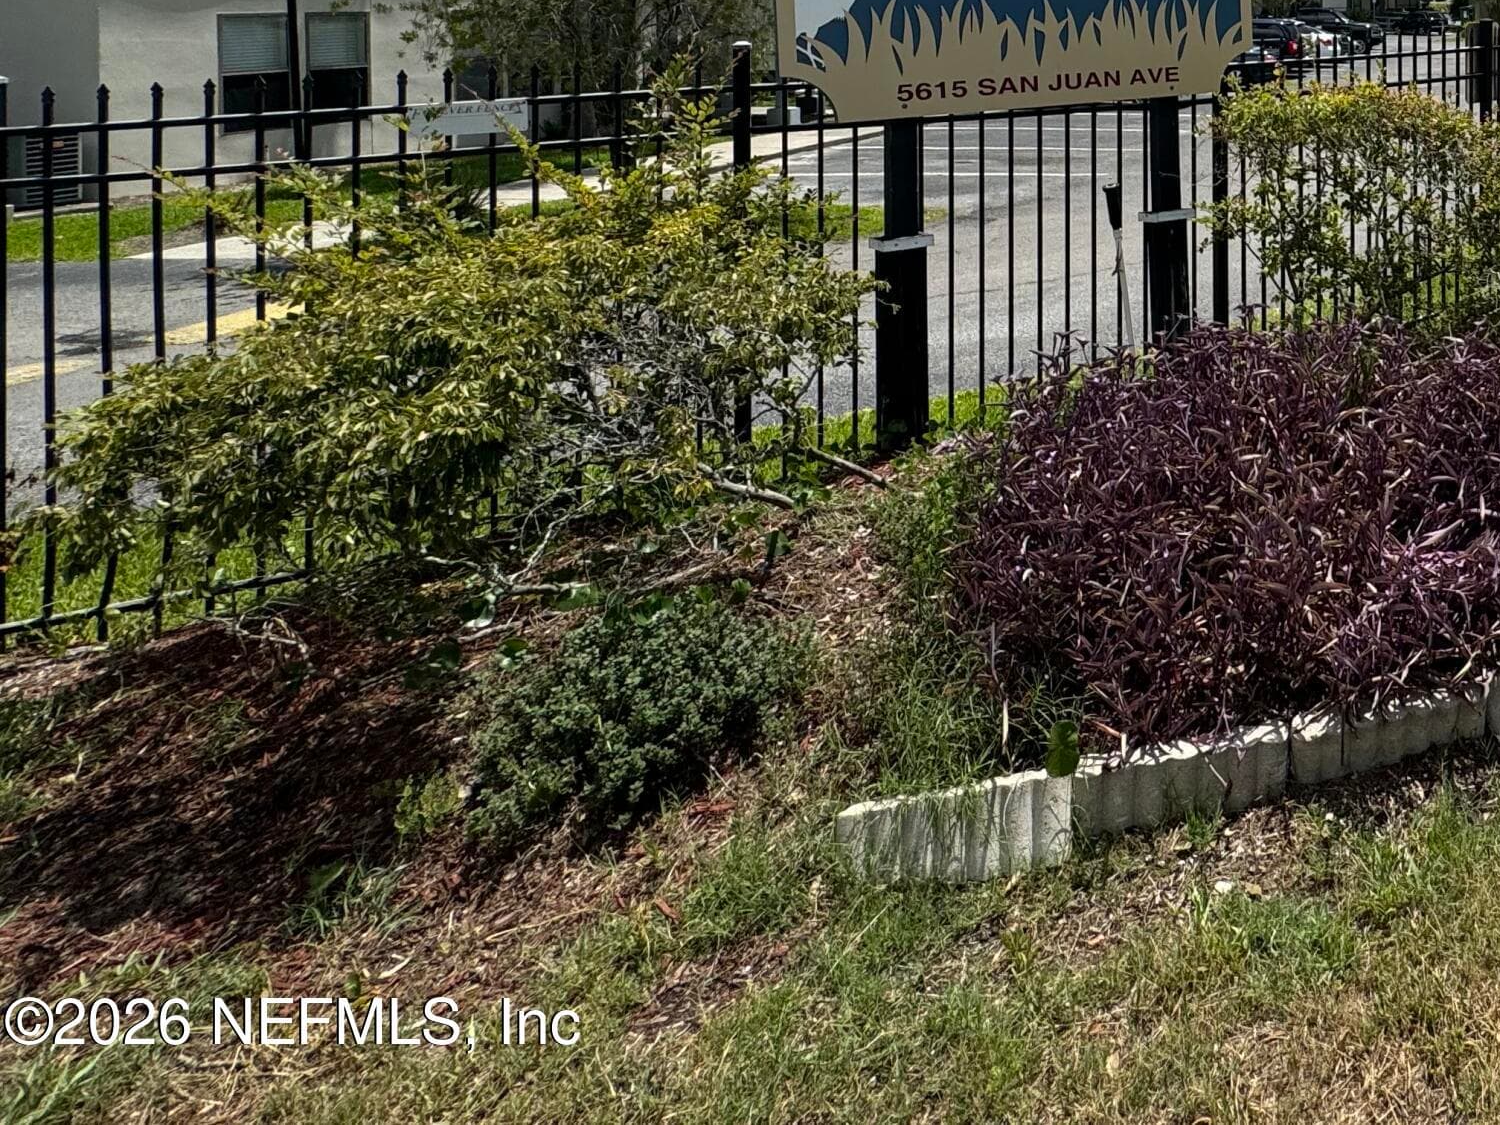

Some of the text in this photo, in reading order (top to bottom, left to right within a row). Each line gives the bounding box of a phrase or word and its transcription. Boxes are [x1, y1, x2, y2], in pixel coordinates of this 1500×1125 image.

[896, 66, 1180, 103] 5615 SAN JUAN AVE
